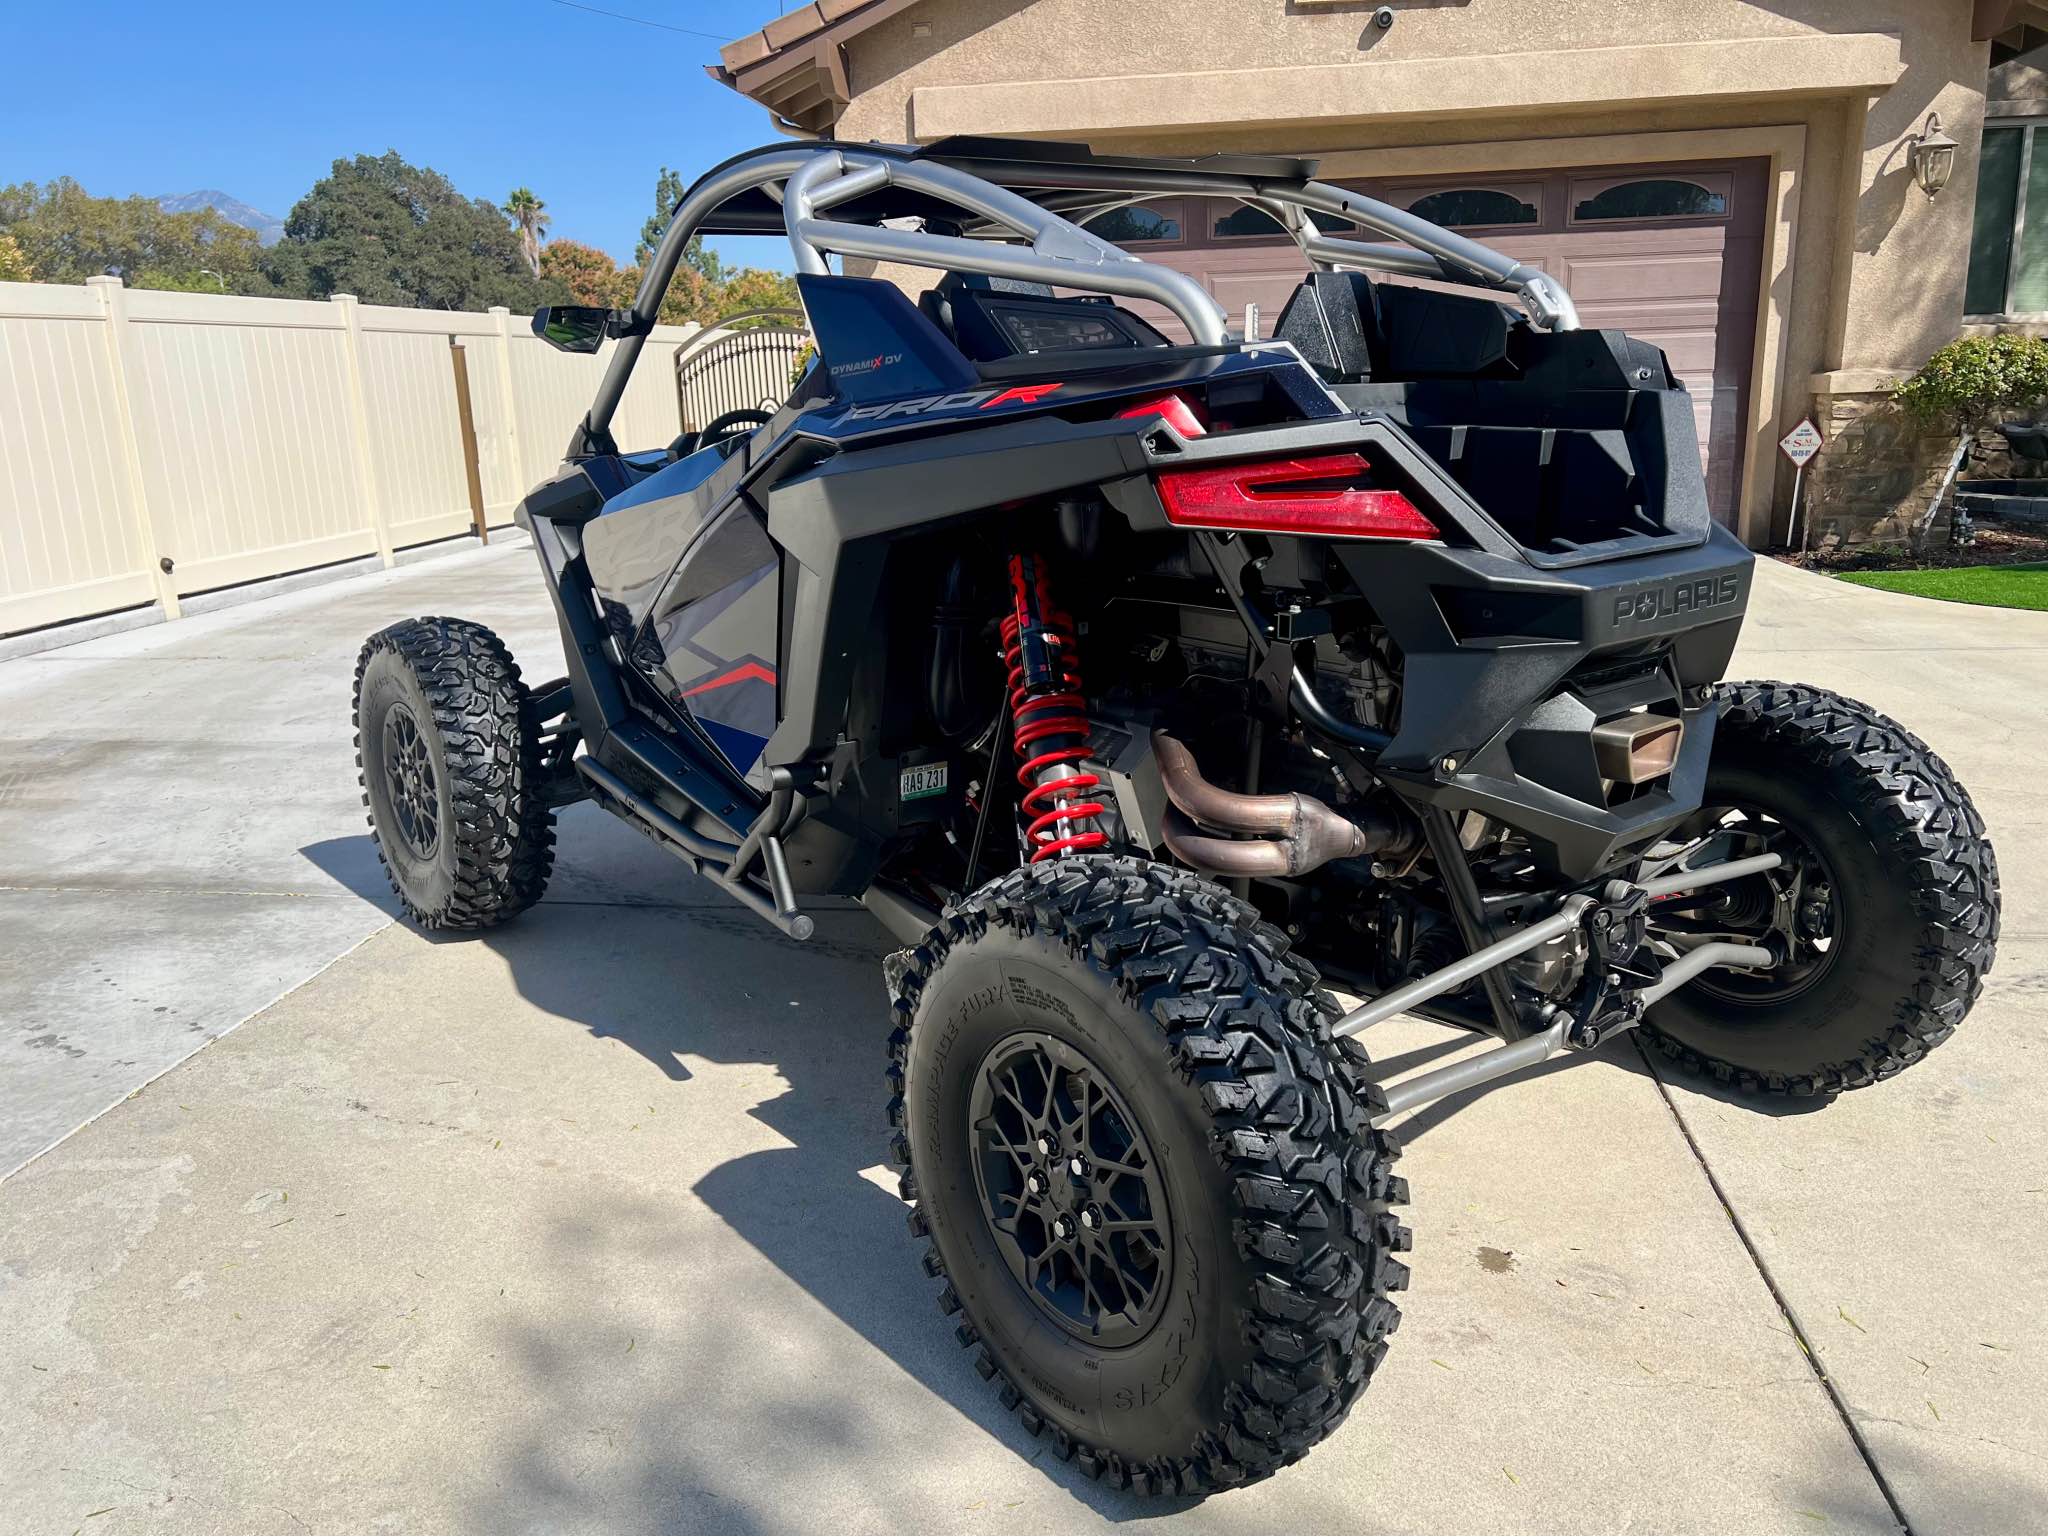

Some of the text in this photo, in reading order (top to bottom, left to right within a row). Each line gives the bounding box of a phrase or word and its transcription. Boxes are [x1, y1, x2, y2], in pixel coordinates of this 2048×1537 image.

[831, 354, 884, 376] DYNAMIX
[885, 353, 903, 366] DV
[830, 389, 1000, 429] PRO
[1612, 572, 1739, 628] POLARIS
[926, 768, 944, 789] Z31
[959, 983, 1006, 1025] FURY
